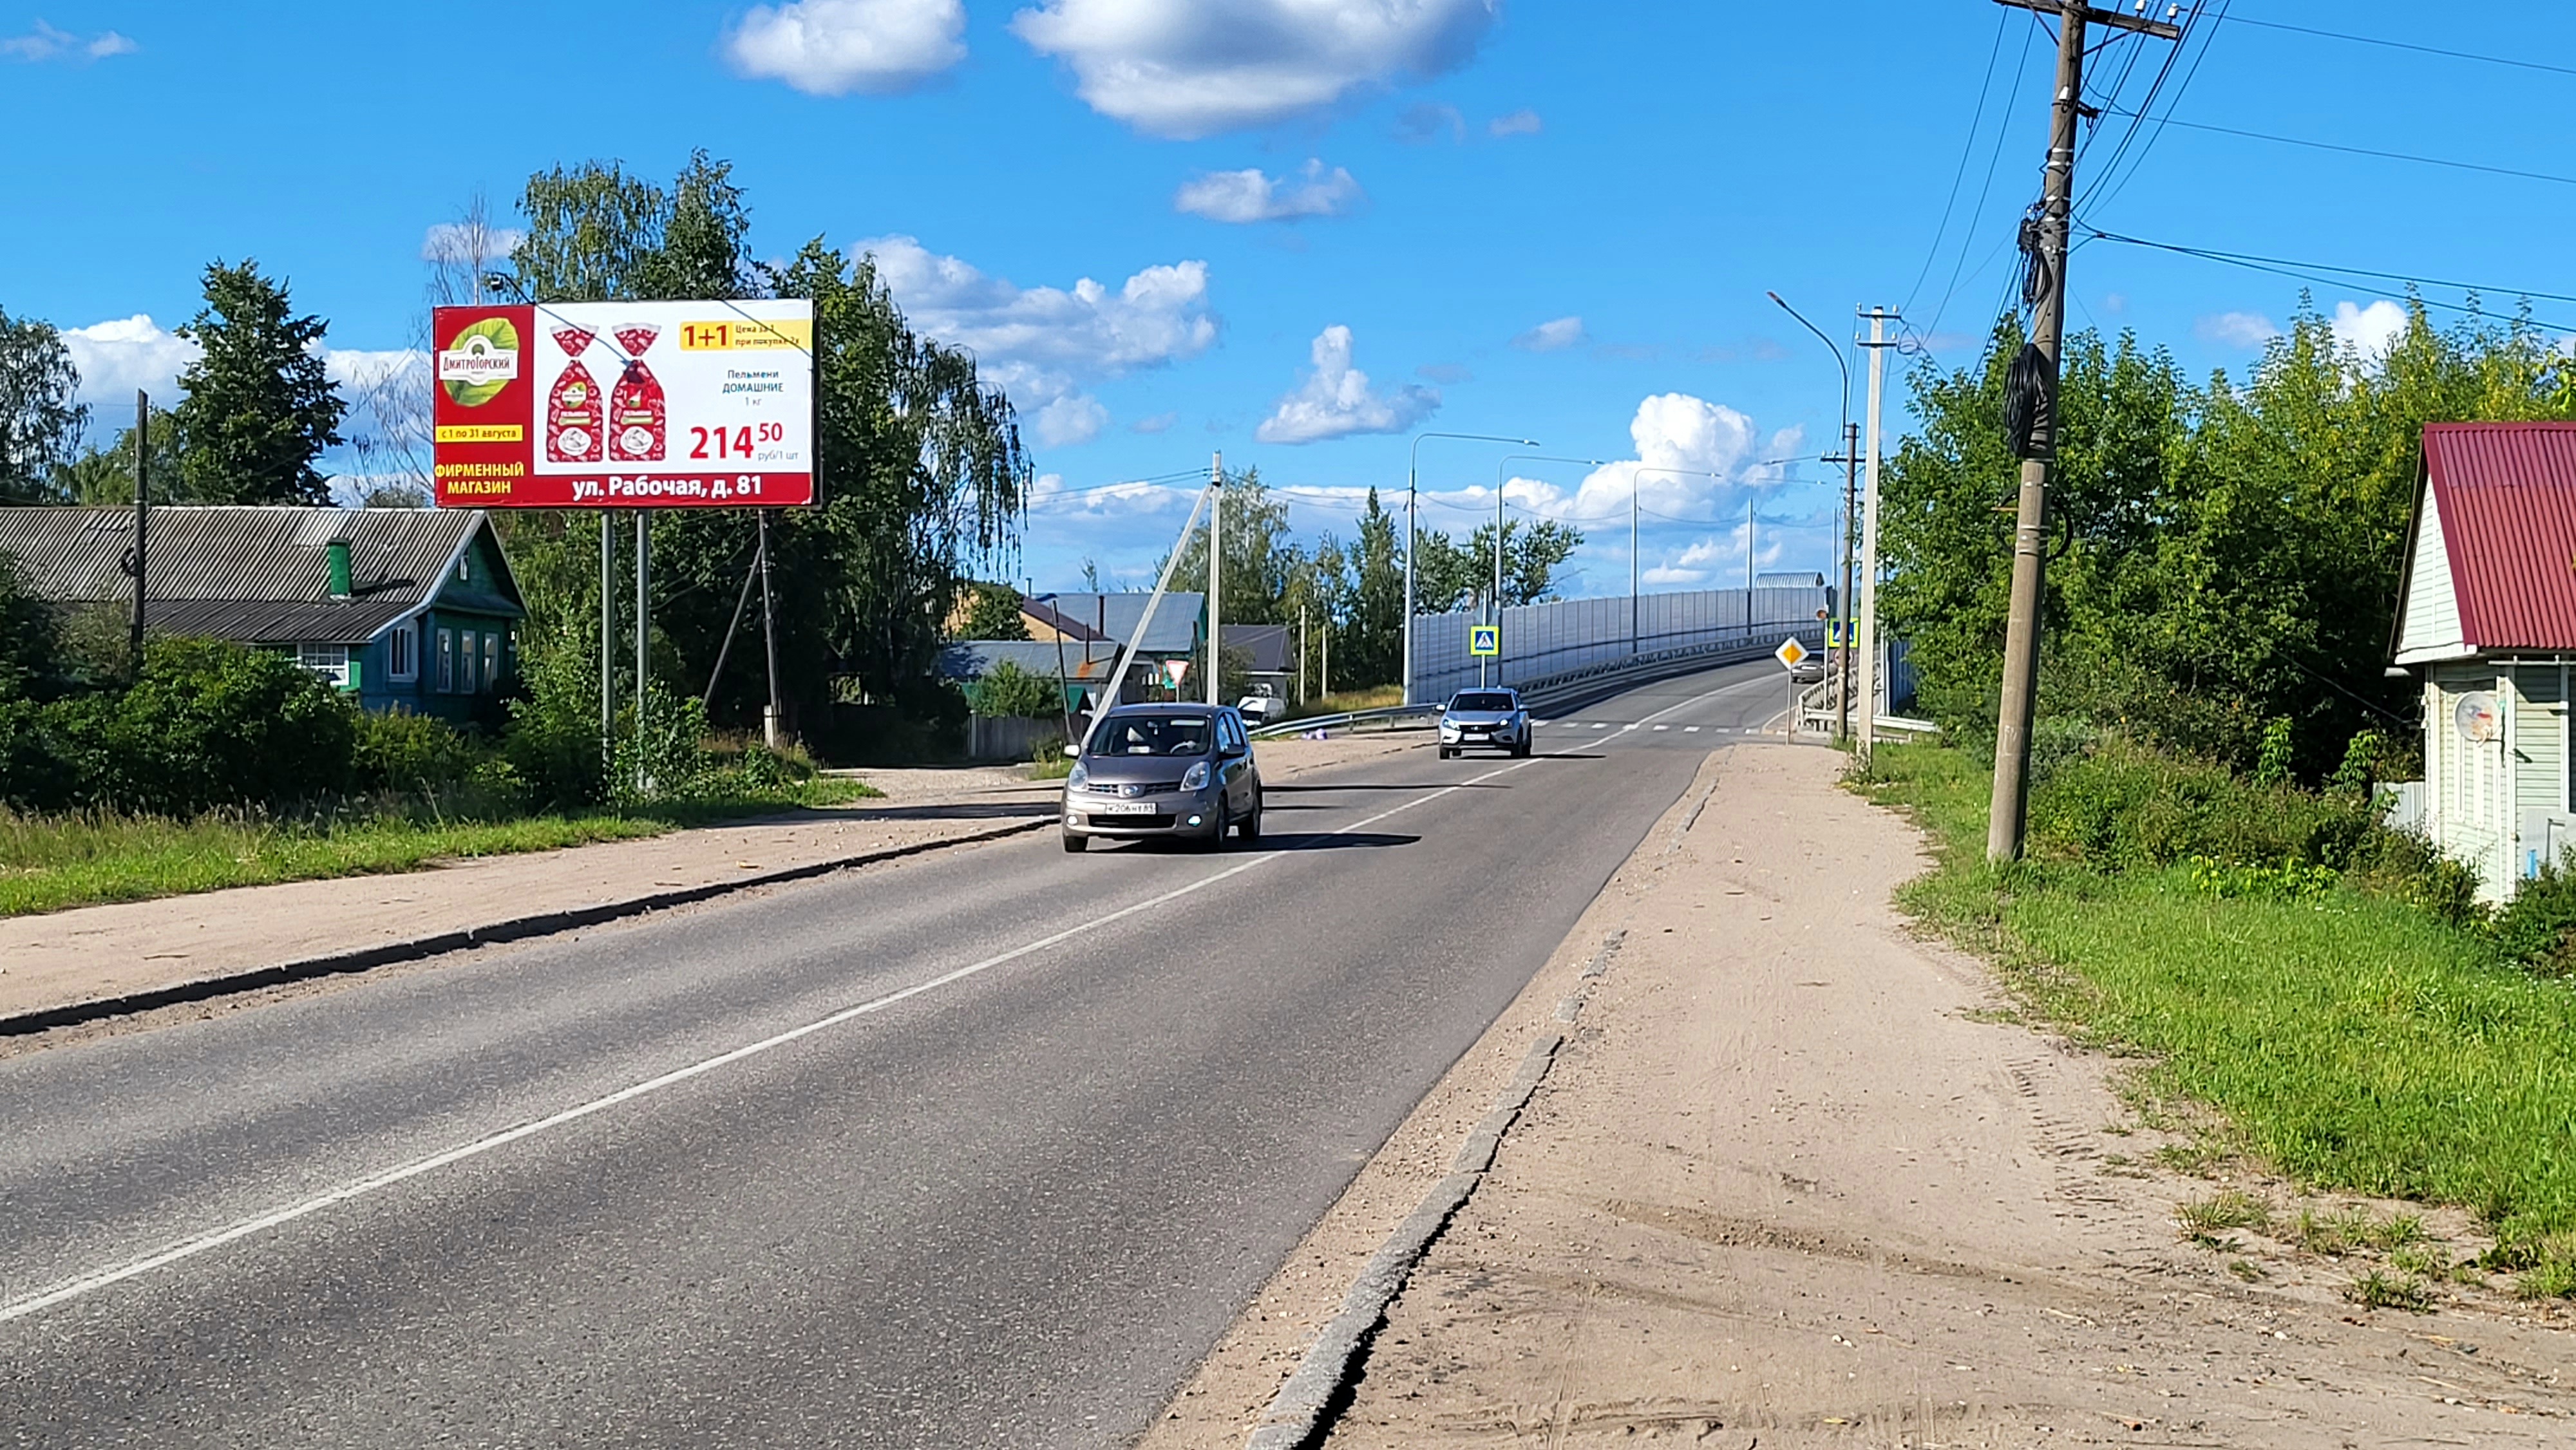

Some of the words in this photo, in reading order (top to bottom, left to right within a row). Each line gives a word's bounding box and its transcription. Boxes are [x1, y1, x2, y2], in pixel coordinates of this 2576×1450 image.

[684, 325, 726, 346] 1+1
[735, 325, 757, 334] Цена
[735, 339, 752, 347] при
[727, 369, 779, 379] Пельмени
[722, 382, 784, 394] ДОМАШНИЕ
[745, 397, 749, 406] 1
[752, 398, 762, 406] кг
[449, 429, 453, 437] 1
[469, 429, 479, 438] 31
[482, 429, 516, 439] августа
[690, 426, 754, 459] 214
[758, 422, 783, 442] 50
[434, 461, 524, 478] ФИРМЕННЫЙ
[447, 480, 511, 494] МАГАЗИН
[572, 480, 605, 502] ул.
[609, 475, 708, 498] Рабочая,
[710, 479, 733, 499] д.
[736, 475, 762, 495] 81
